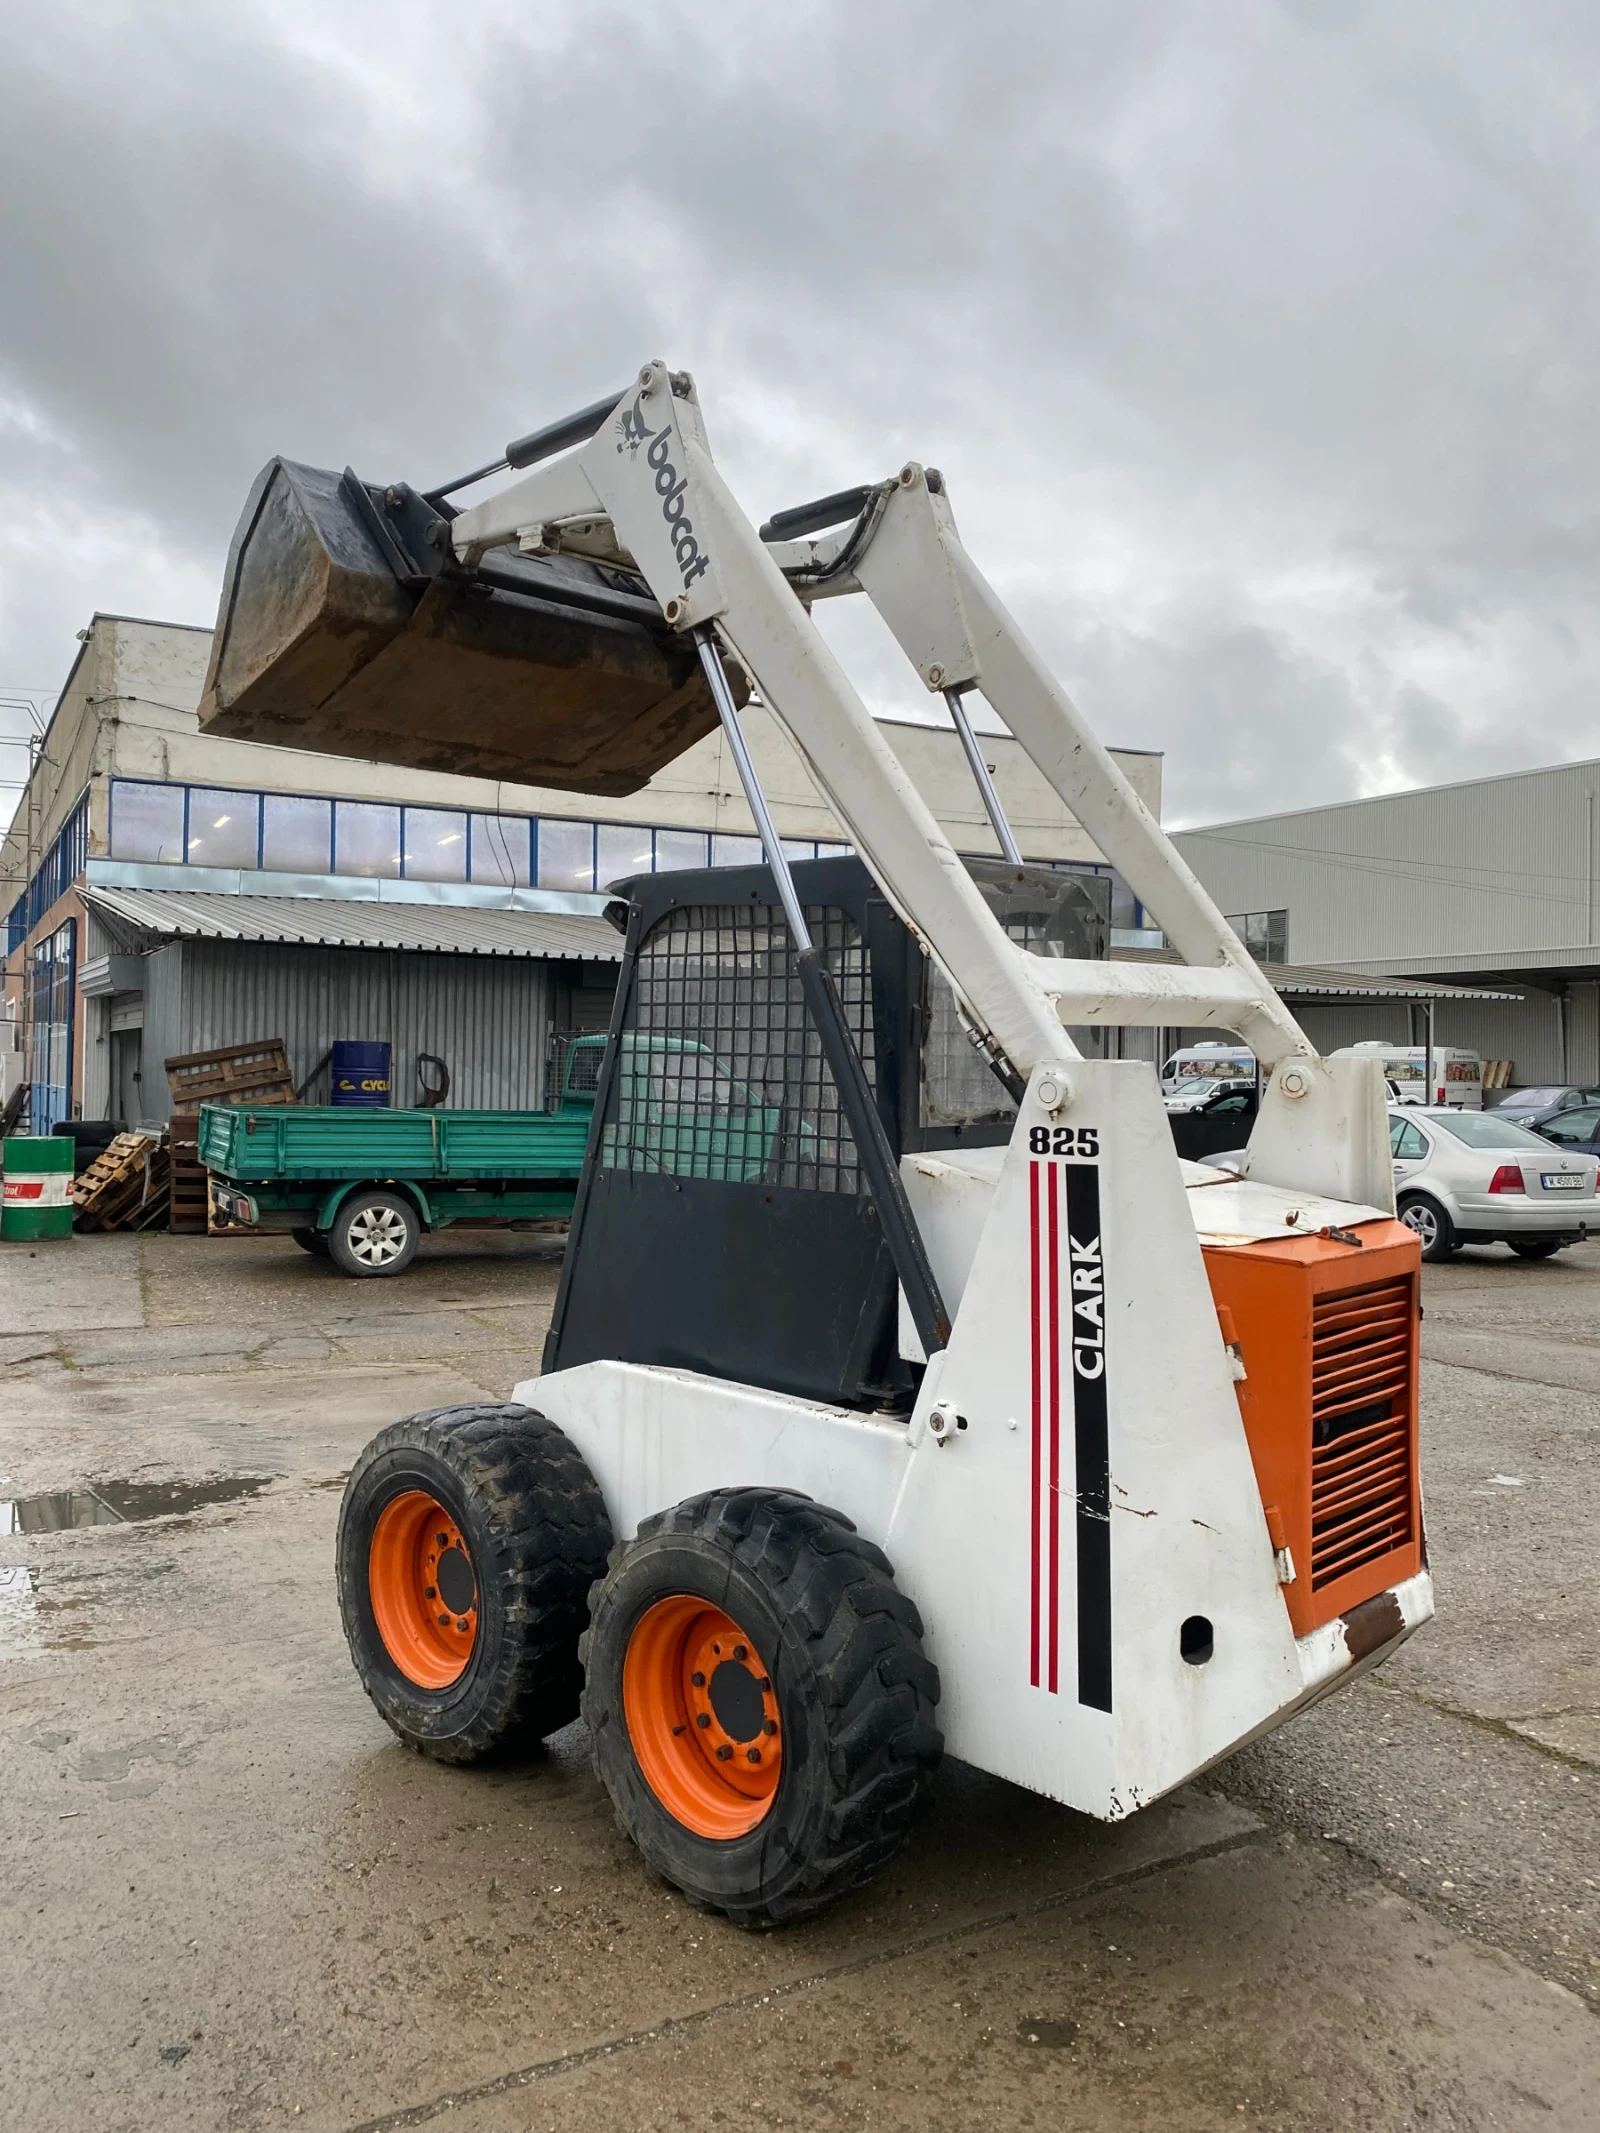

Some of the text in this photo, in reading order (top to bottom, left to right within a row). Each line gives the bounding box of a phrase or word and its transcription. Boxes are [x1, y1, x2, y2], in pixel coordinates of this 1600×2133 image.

[647, 424, 710, 590] bobcat
[1029, 1126, 1100, 1158] 825
[1069, 1234, 1104, 1380] CLARK
